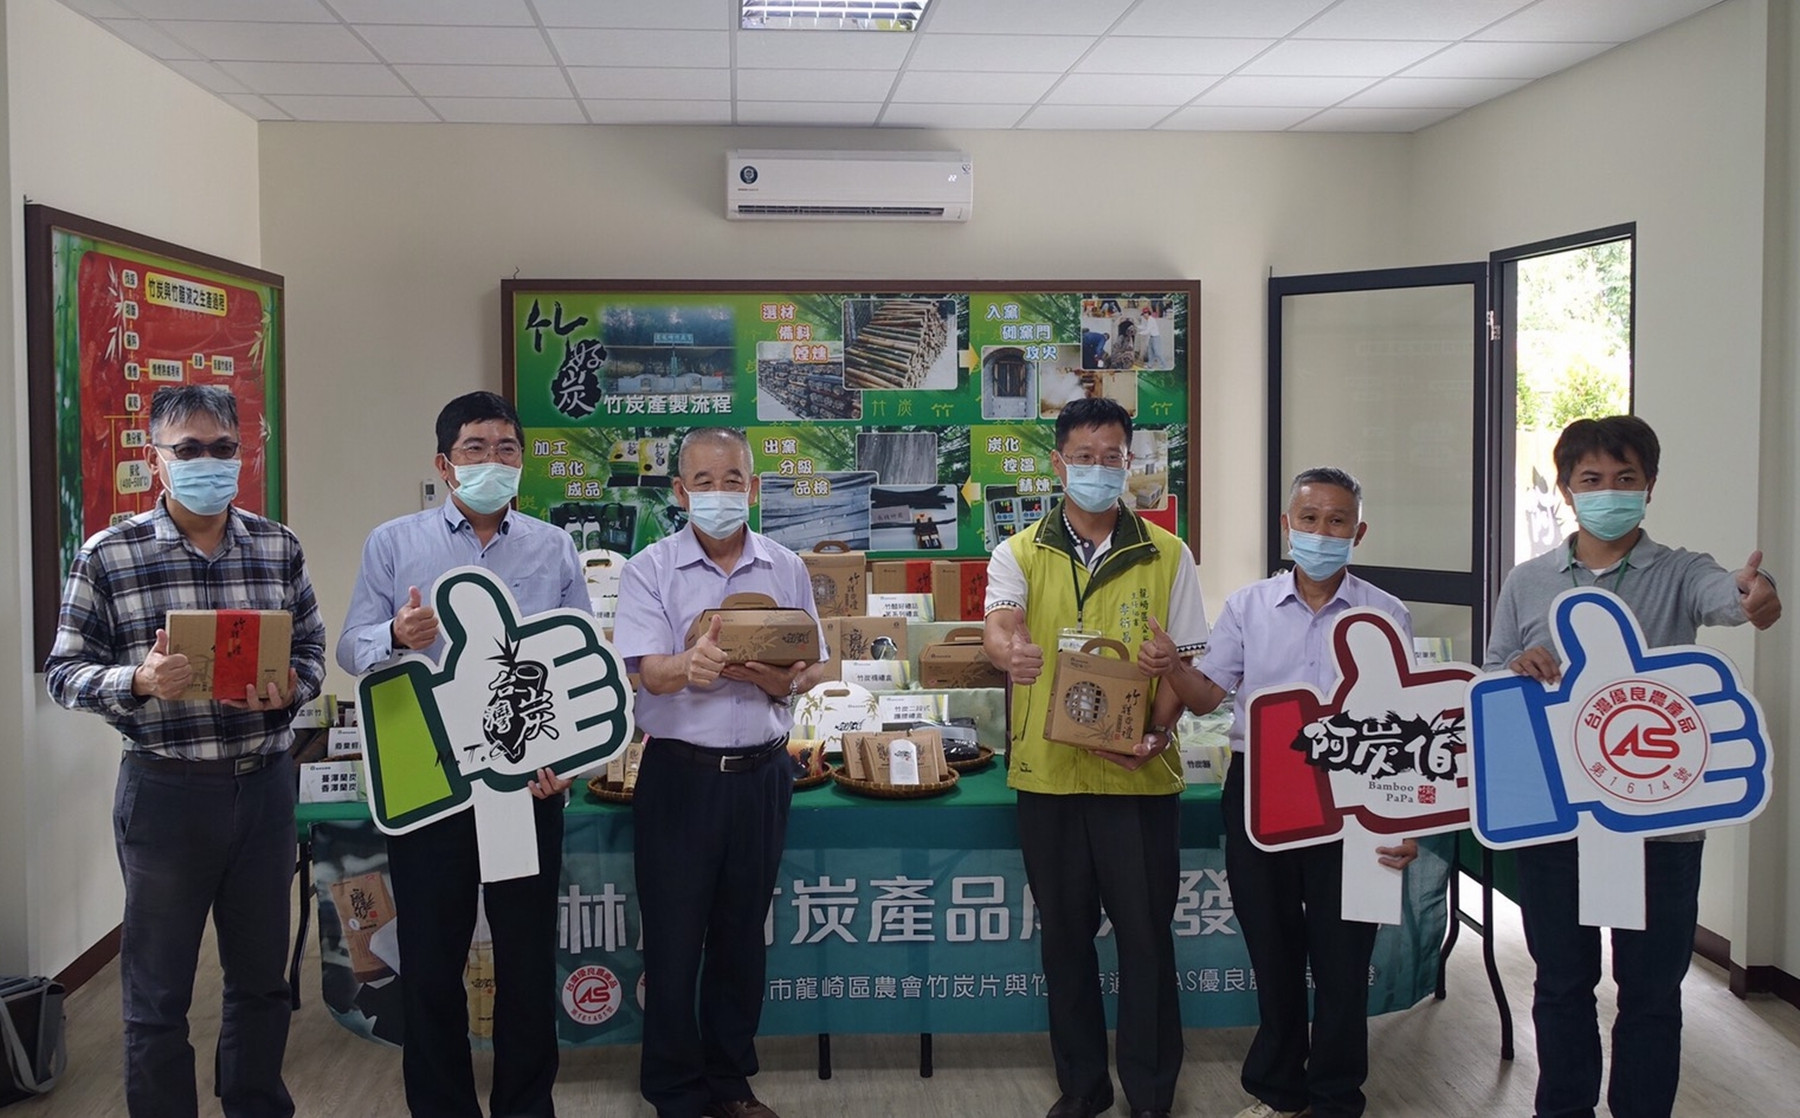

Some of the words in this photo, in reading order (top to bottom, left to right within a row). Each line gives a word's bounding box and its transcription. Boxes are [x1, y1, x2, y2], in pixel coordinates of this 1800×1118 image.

[148, 278, 226, 312] 竹炭與竹醋液之生產過程
[762, 304, 797, 320] 選材
[778, 325, 811, 341] 備料
[603, 393, 732, 415] 竹炭產製流程
[534, 440, 567, 456] 加工
[987, 437, 1020, 453] 炭化
[550, 461, 585, 477] 商化
[780, 459, 813, 475] 分級
[1003, 457, 1036, 473] 控溫
[567, 482, 601, 498] 成品
[796, 480, 830, 496] 品檢
[1583, 686, 1697, 734] 台灣優良農產品
[1368, 780, 1415, 792] Bamboo
[1386, 793, 1415, 804] PaPa
[565, 967, 619, 992] 台灣優良農產品
